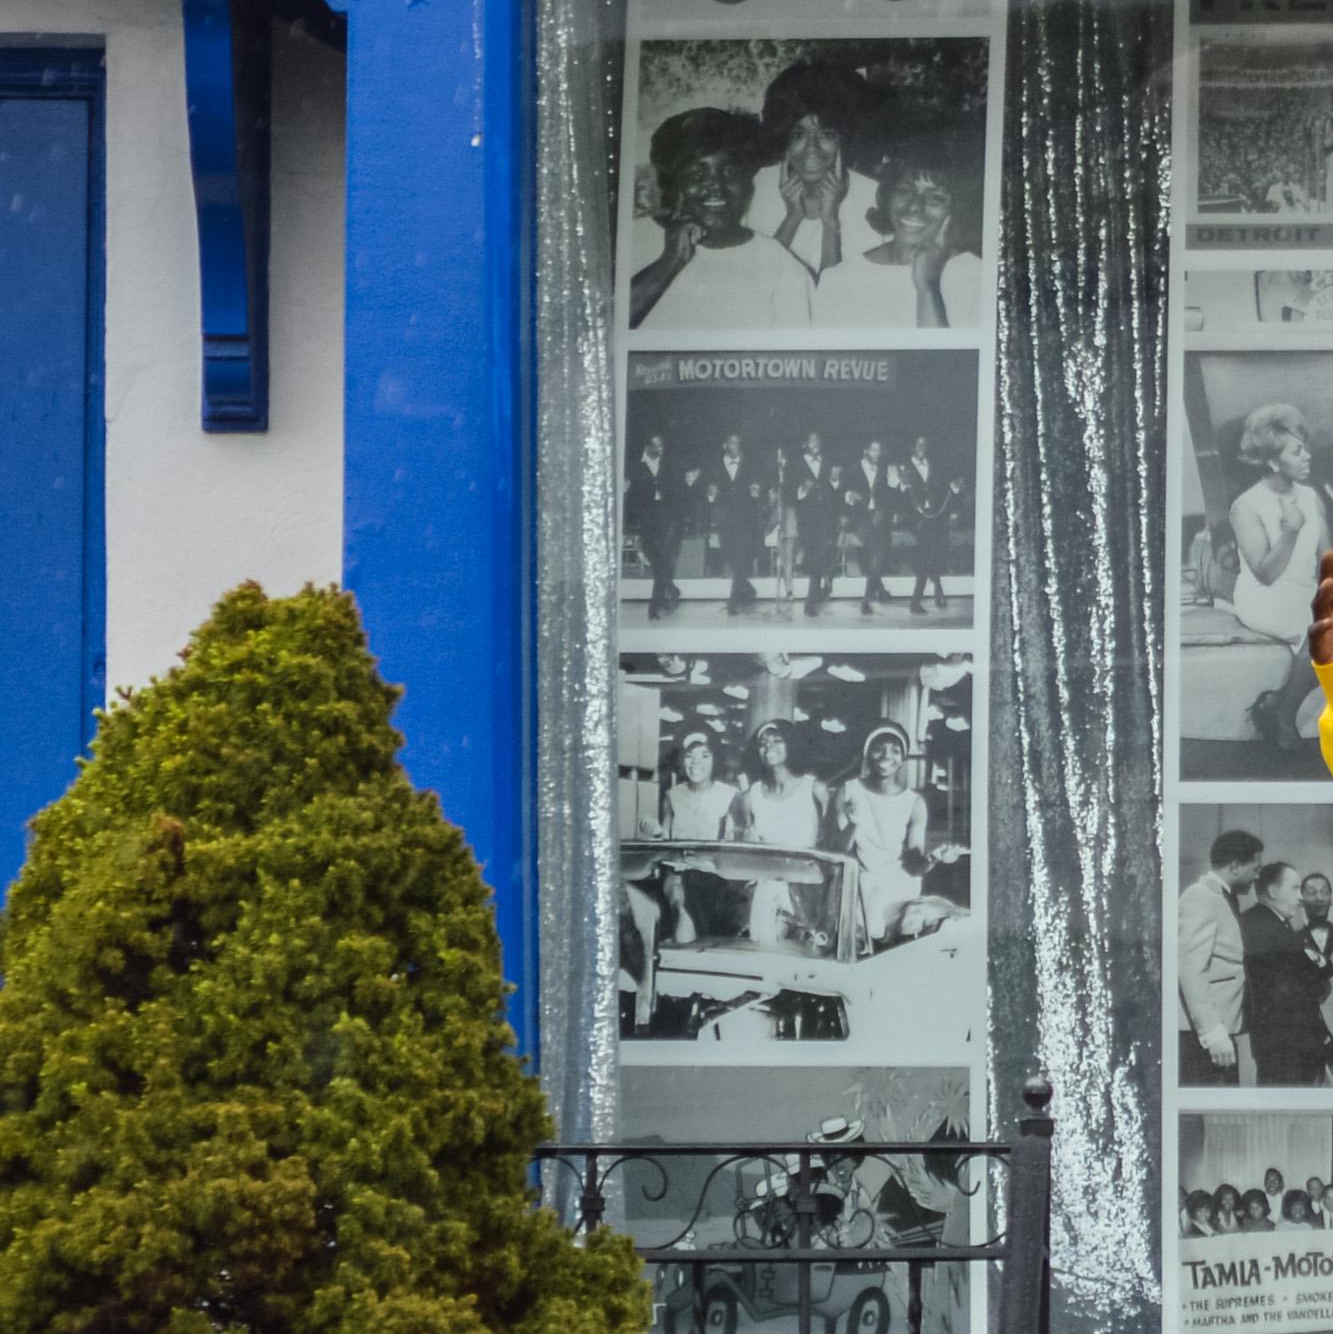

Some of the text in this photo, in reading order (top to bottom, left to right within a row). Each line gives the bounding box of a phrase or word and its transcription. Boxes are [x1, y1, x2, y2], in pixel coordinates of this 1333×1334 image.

[1195, 226, 1320, 244] DETROIT
[677, 358, 816, 382] MOTORTOWN
[823, 358, 890, 382] REVUE
[1190, 1299, 1209, 1312] THE
[1215, 1294, 1275, 1310] SUPREMES
[1192, 1315, 1236, 1328] MARTHA
[1240, 1313, 1259, 1325] AND
[1263, 1311, 1282, 1323] THE
